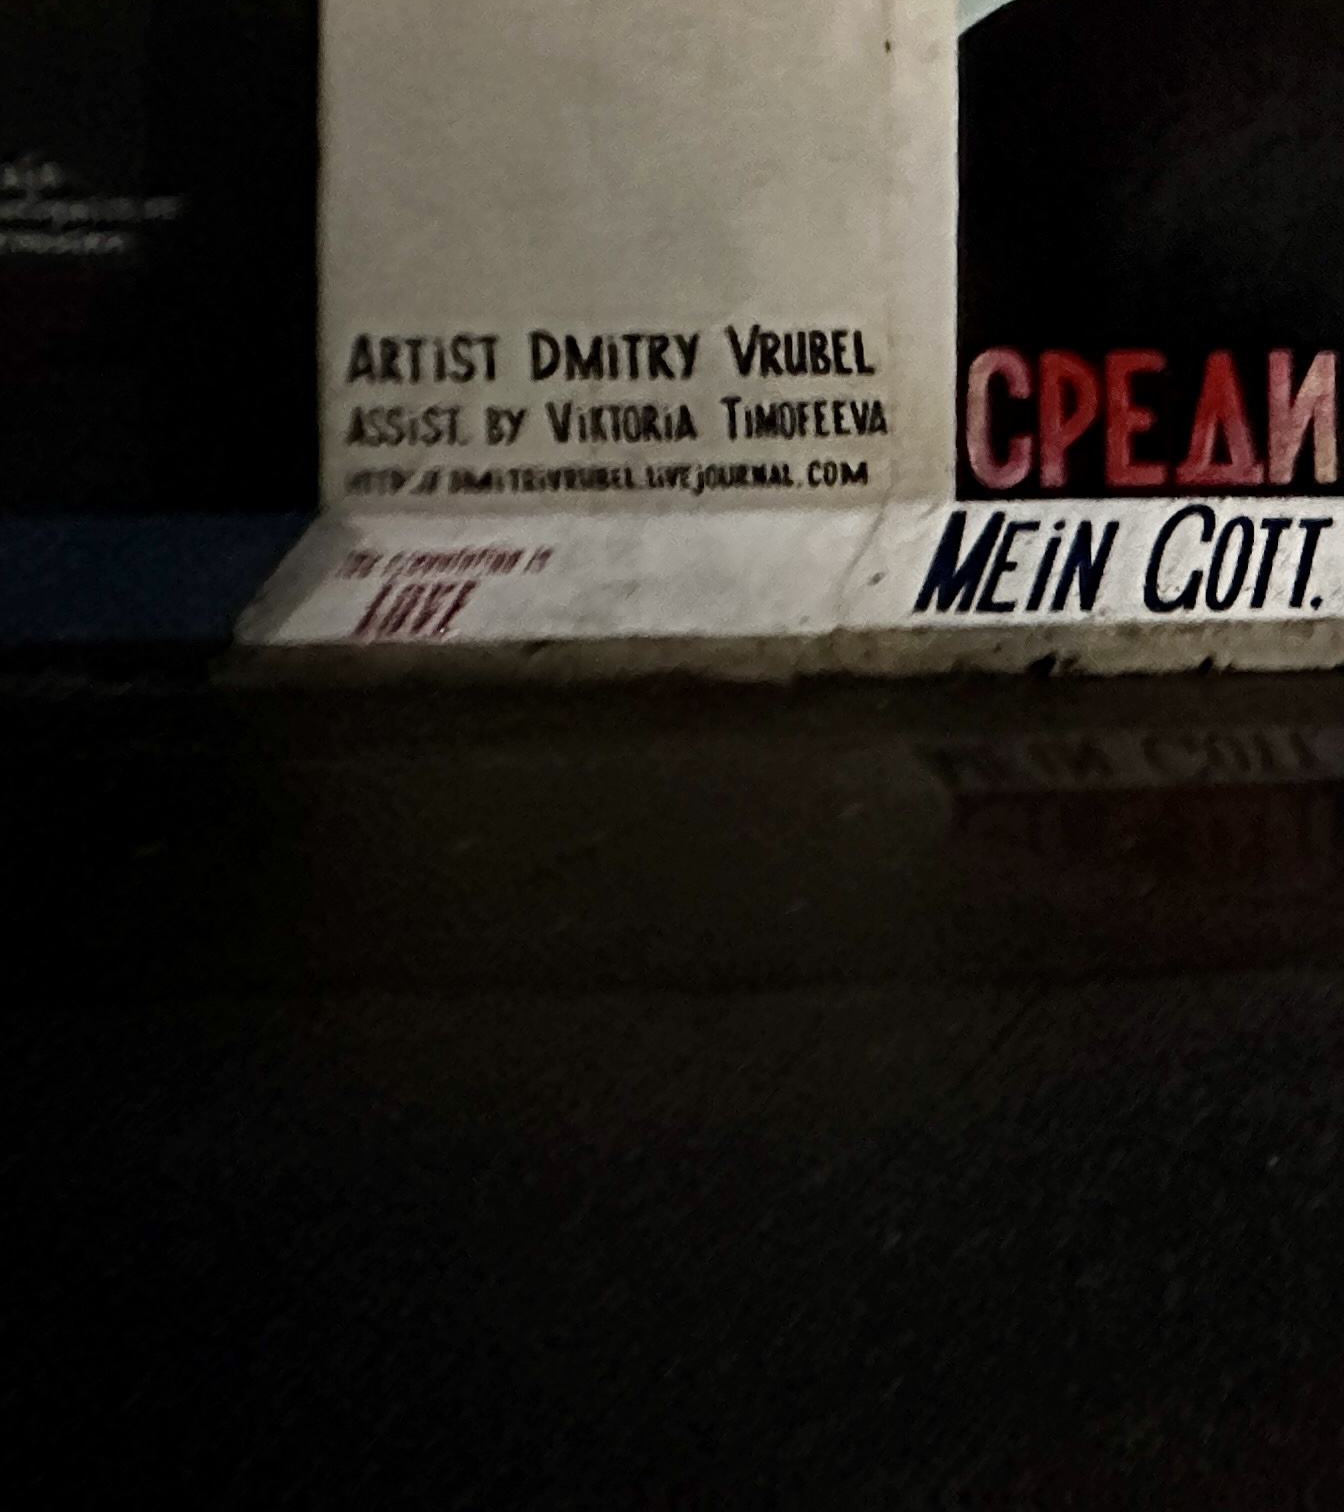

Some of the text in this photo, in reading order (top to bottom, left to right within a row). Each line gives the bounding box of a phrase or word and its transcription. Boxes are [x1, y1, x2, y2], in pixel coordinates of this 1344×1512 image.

[725, 324, 876, 377] VRUBEL
[485, 403, 527, 446] BY
[966, 345, 1337, 487] СРЕДИ
